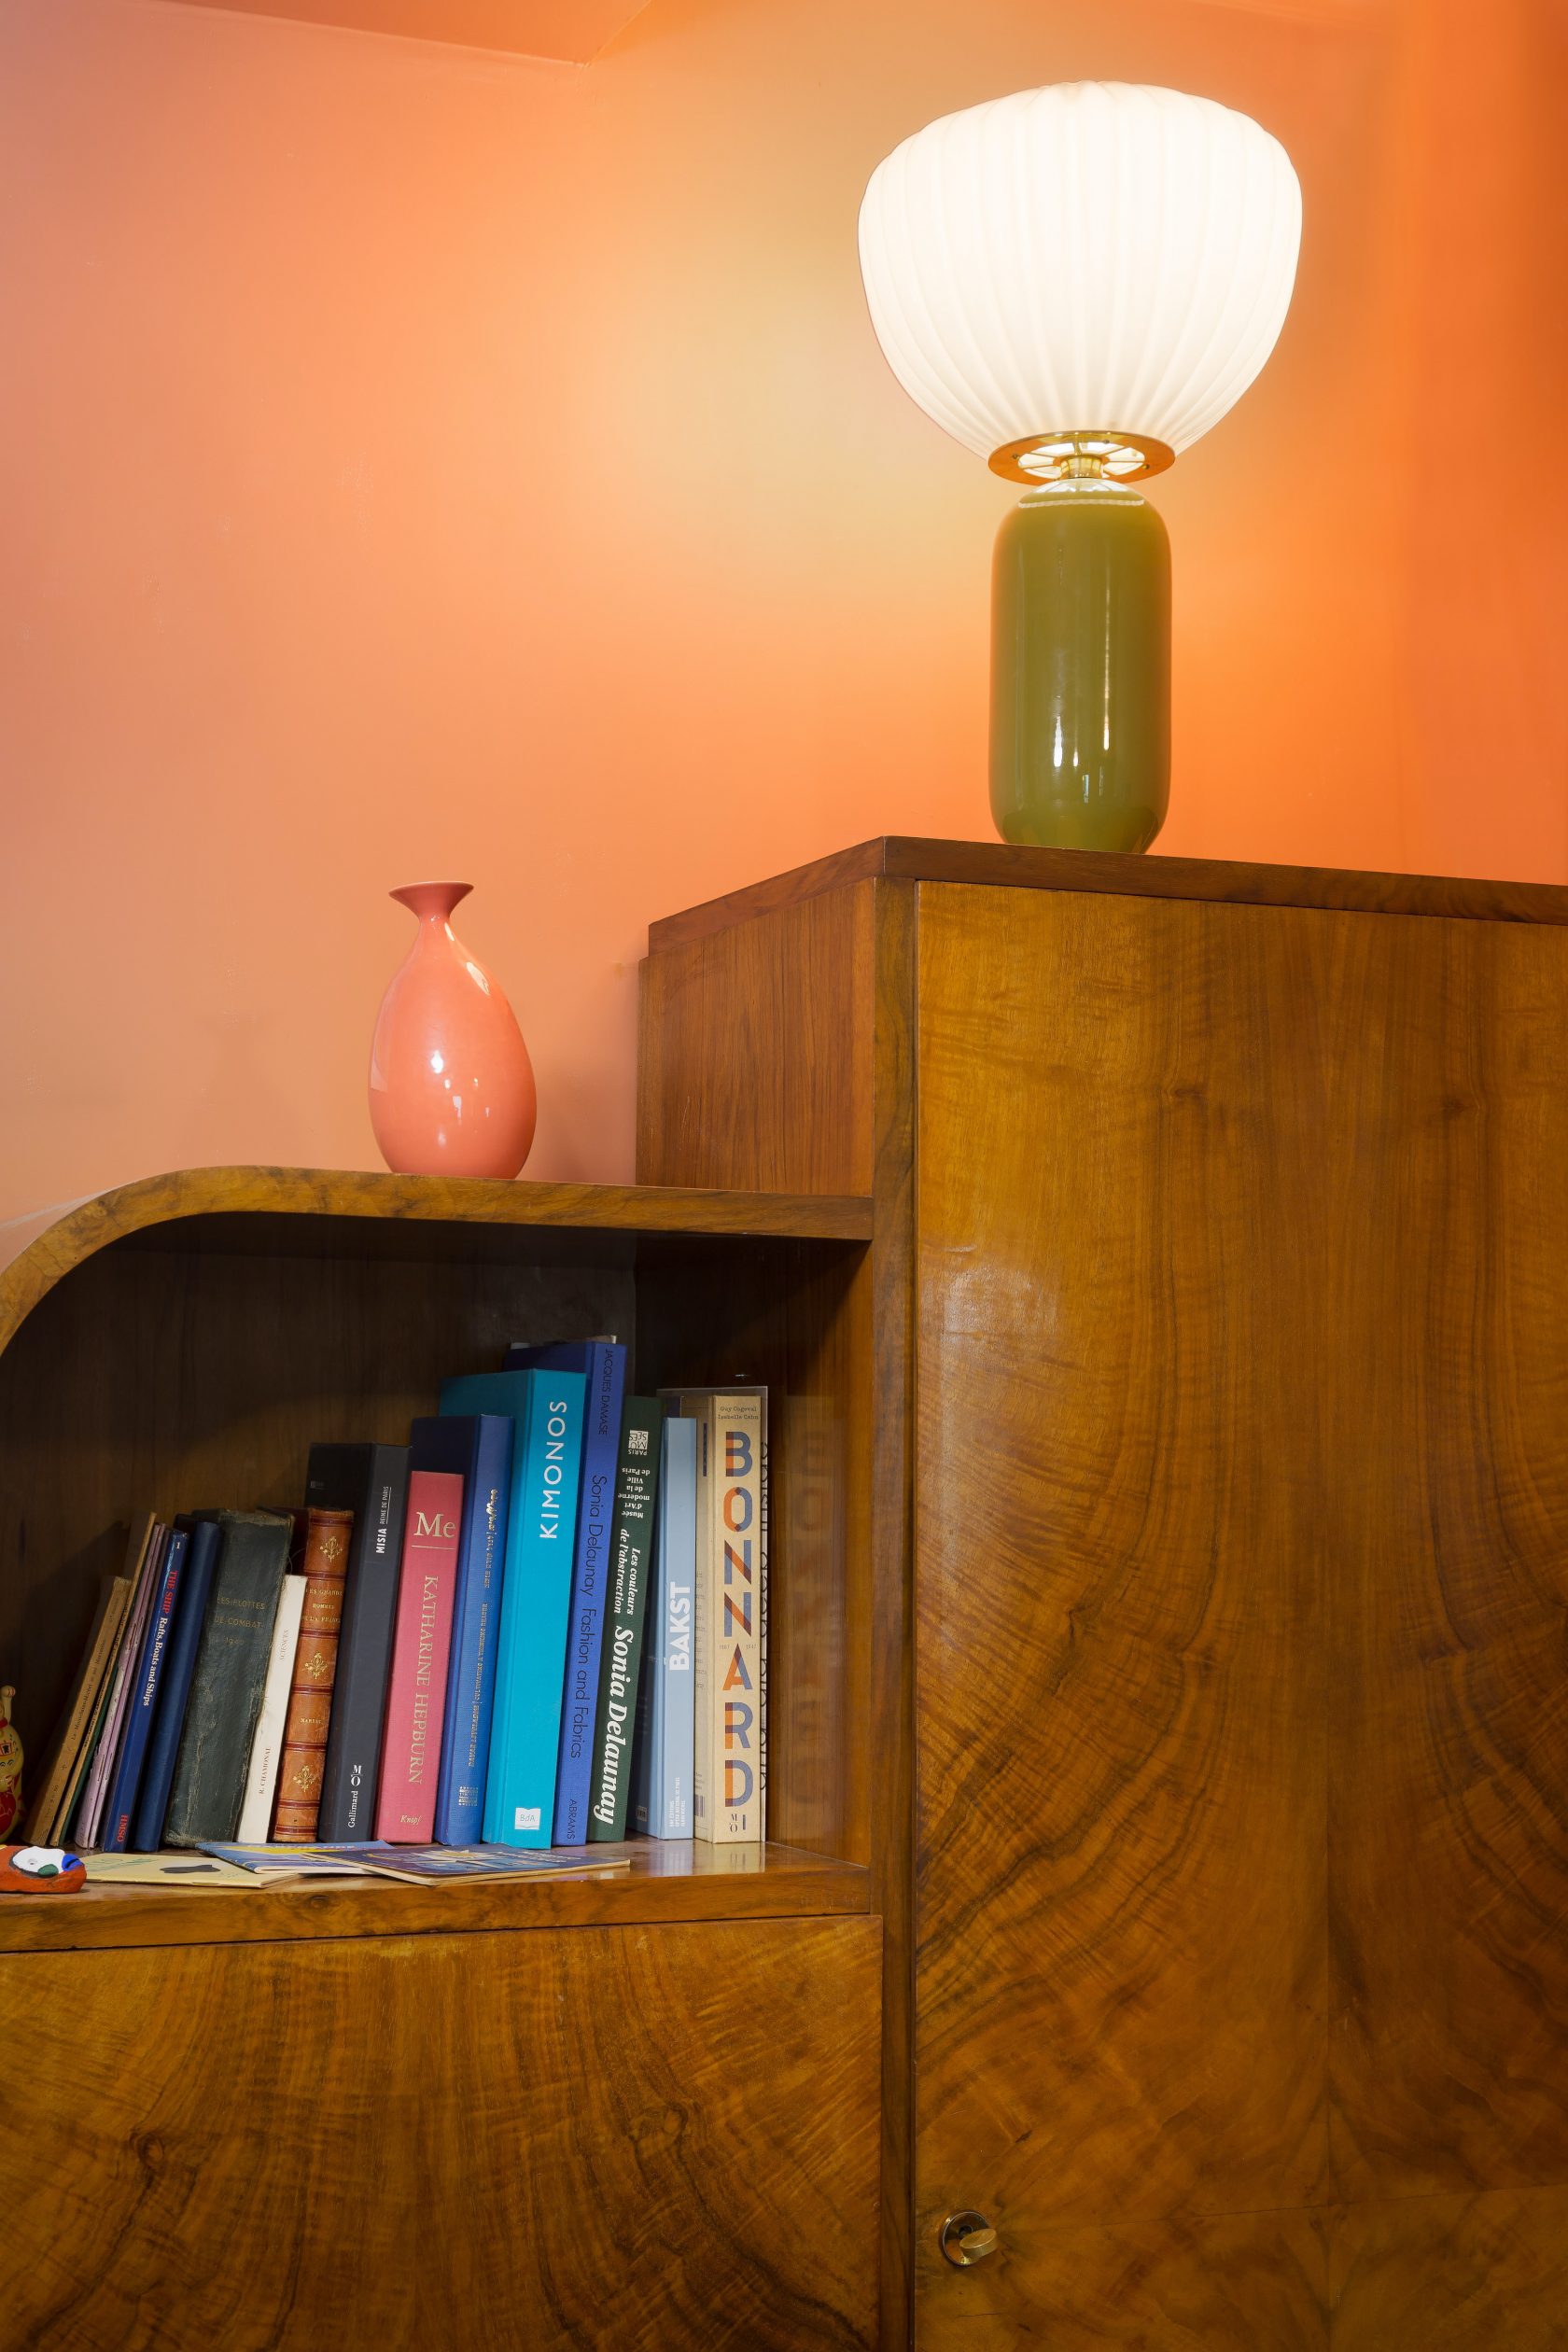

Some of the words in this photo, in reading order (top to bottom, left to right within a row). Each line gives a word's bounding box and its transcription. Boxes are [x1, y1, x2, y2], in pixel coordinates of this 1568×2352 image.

[602, 1349, 613, 1393] JACQUES
[598, 1395, 610, 1435] DAMASE
[539, 1401, 567, 1539] KIMONOS
[622, 1467, 640, 1476] Paris
[590, 1475, 608, 1518] Sonia
[624, 1502, 643, 1510] d'Art
[376, 1528, 387, 1554] MISIA
[413, 1511, 456, 1538] Me
[620, 1529, 630, 1543] de
[580, 1523, 604, 1597] Delaunay
[630, 1547, 641, 1566] Les
[166, 1570, 177, 1589] THE
[613, 1544, 629, 1614] l'abstraction
[627, 1567, 638, 1616] couleurs
[162, 1589, 174, 1615] SHIP
[722, 1431, 754, 1808] BONNARD
[416, 1575, 439, 1687] KATHARINE
[578, 1608, 597, 1664] Fashion
[669, 1581, 691, 1671] BAKST
[151, 1641, 163, 1666] Boats
[609, 1626, 634, 1697] Sonia
[147, 1665, 158, 1683] and
[575, 1670, 590, 1700] and
[143, 1682, 155, 1706] Ships
[408, 1693, 429, 1785] HEPBURN
[571, 1706, 589, 1759] Fabrics
[594, 1700, 628, 1825] Delaunay
[117, 1814, 129, 1843] HMSO
[347, 1790, 358, 1828] Gallimard
[399, 1814, 422, 1826] Knopf
[520, 1813, 536, 1822] BdA
[567, 1799, 578, 1840] ABRAMS
